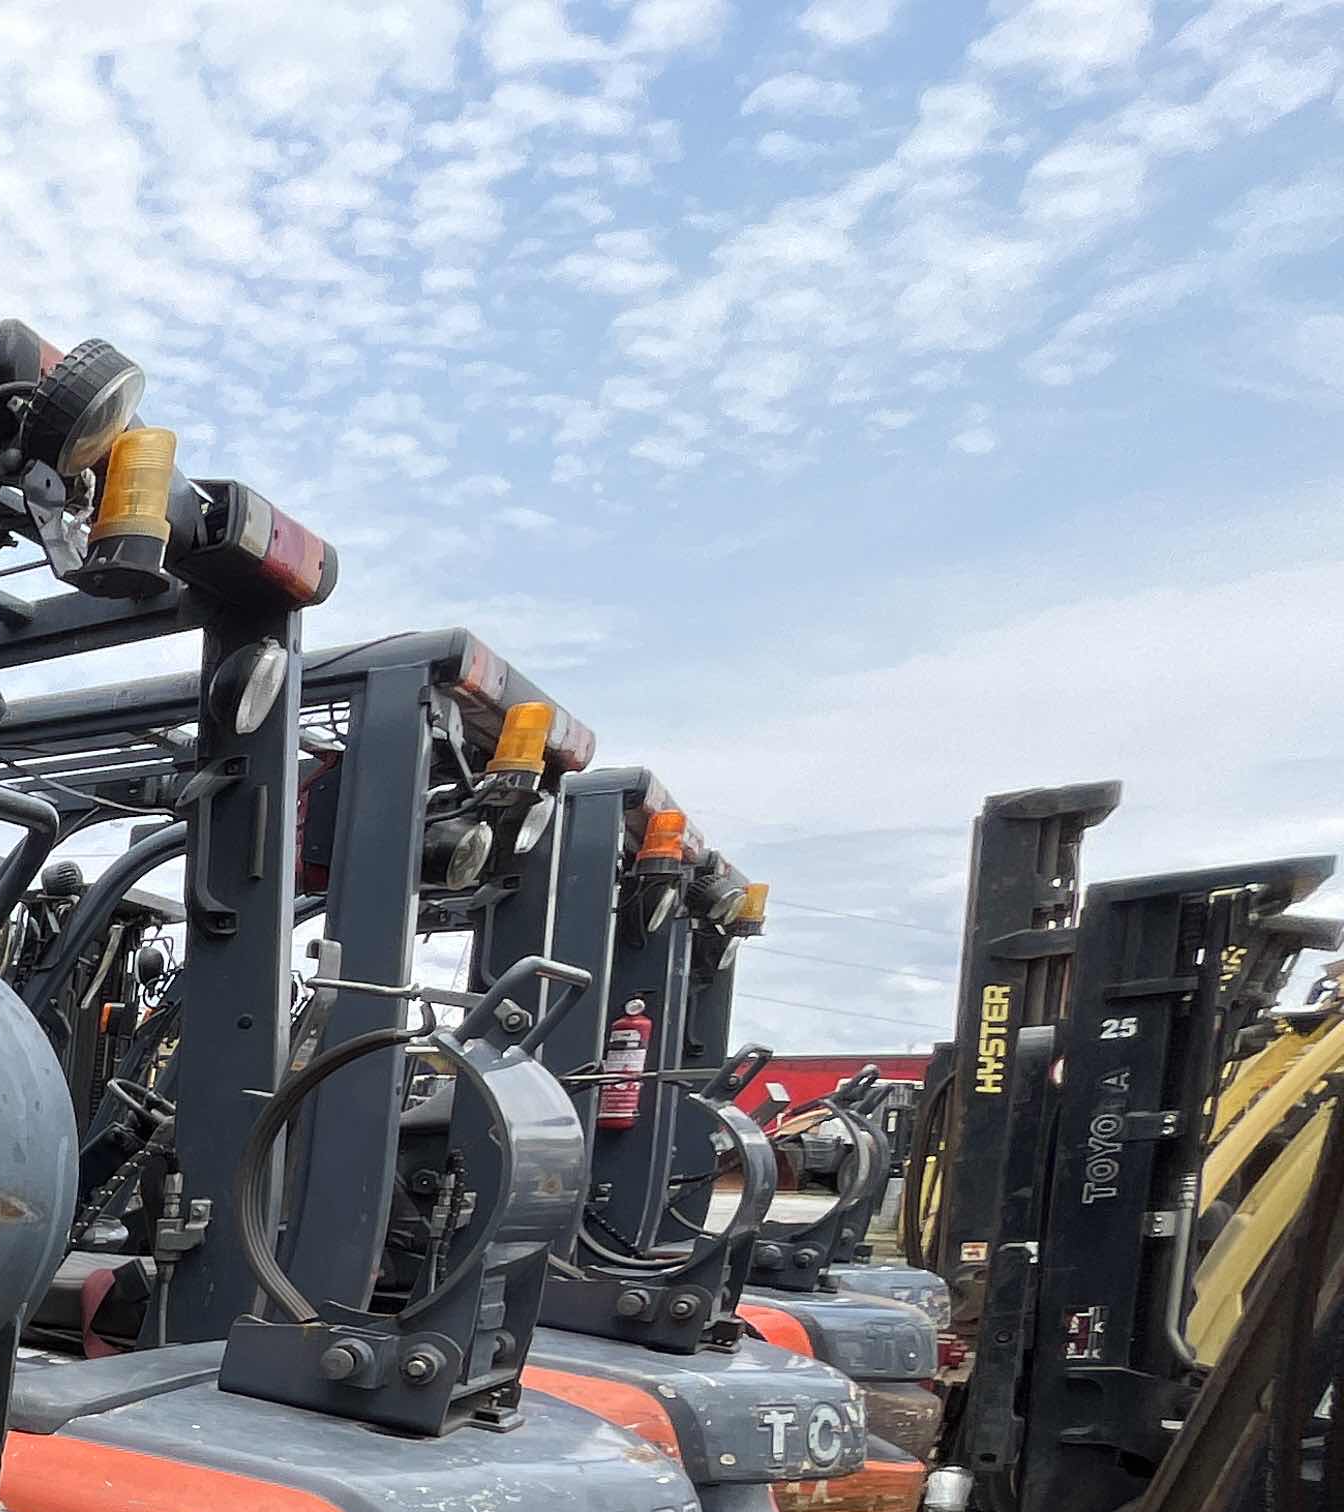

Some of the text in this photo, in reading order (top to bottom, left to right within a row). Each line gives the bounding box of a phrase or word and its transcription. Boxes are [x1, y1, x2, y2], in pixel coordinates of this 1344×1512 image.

[975, 985, 1011, 1093] HYSTER
[1099, 1016, 1138, 1039] 25
[1081, 1066, 1131, 1204] TOYOA
